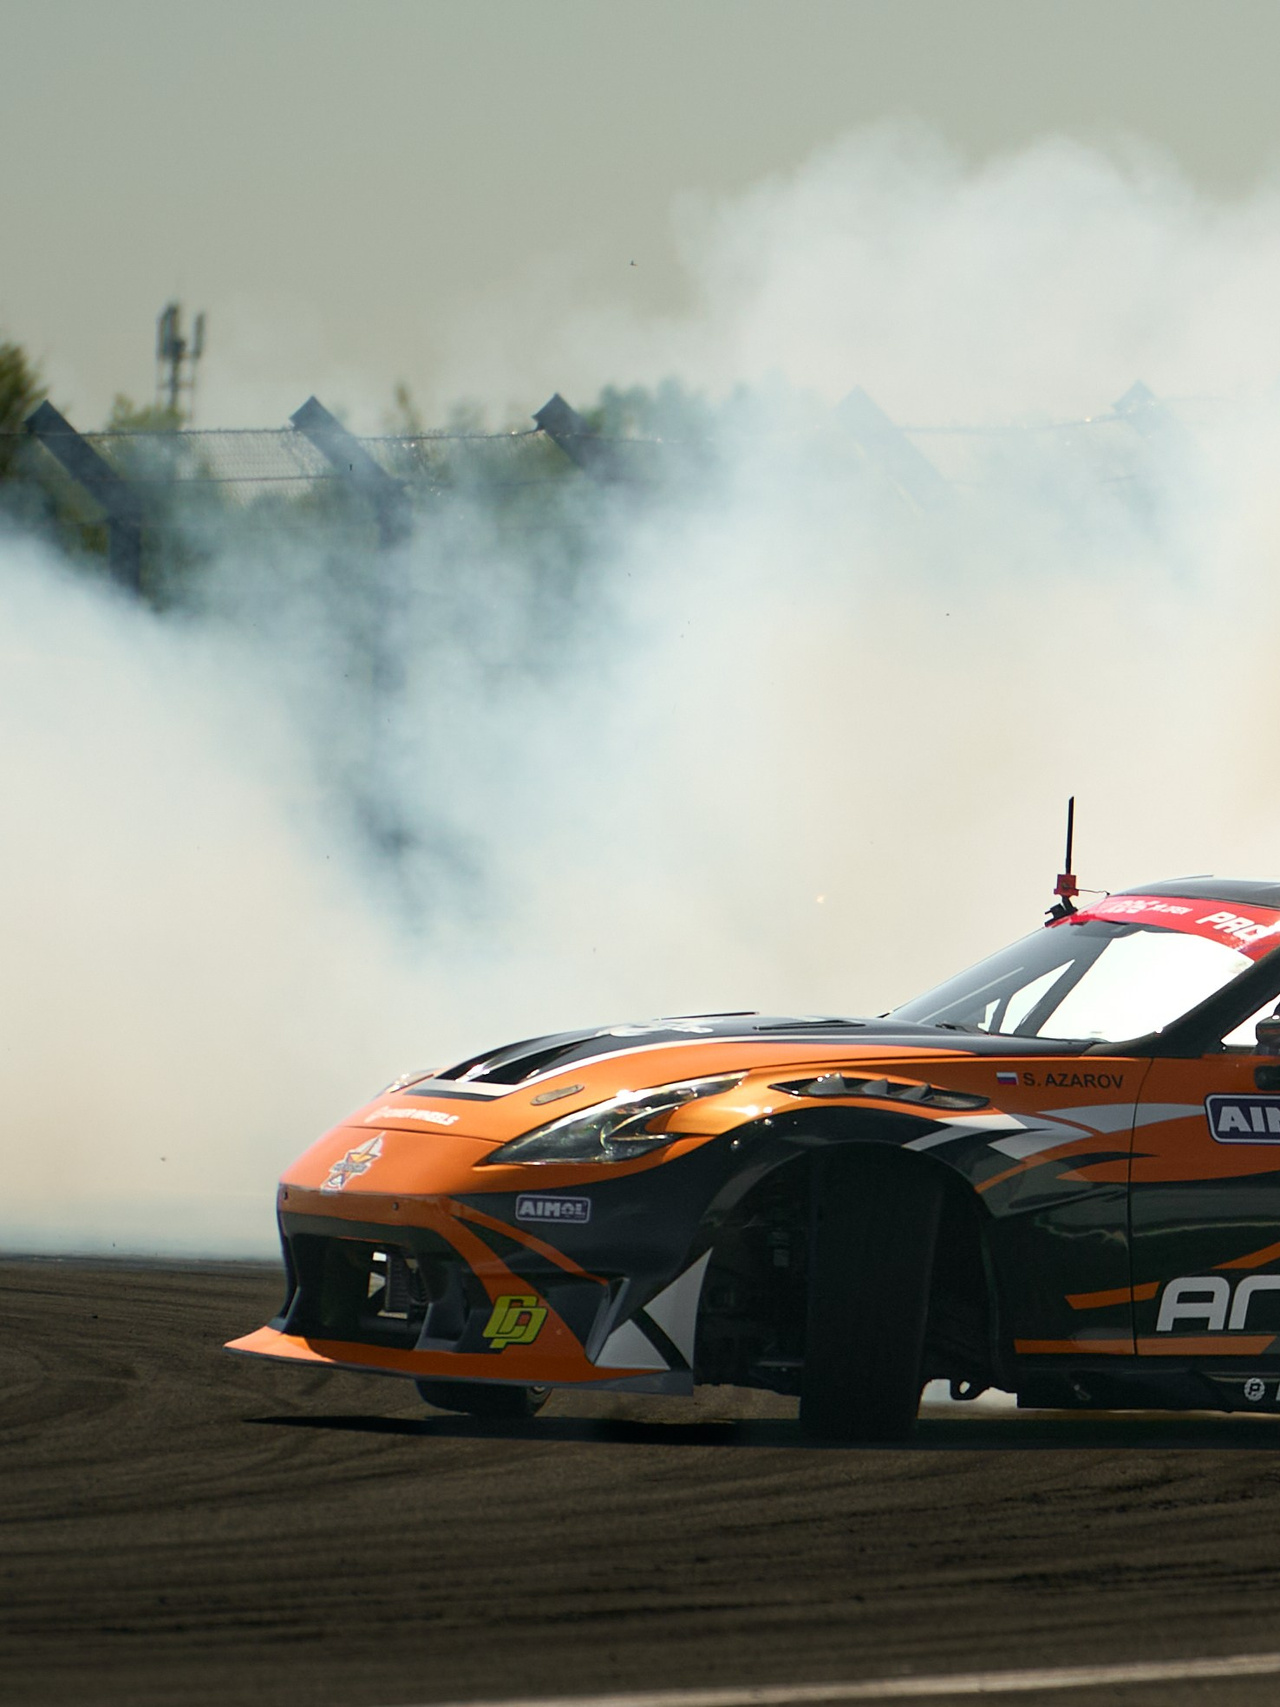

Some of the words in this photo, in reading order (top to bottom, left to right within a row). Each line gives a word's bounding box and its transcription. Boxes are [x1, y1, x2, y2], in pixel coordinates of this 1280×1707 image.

[1023, 1073, 1041, 1087] S.
[1045, 1073, 1123, 1088] AZAROV
[519, 1201, 586, 1217] AIMOL
